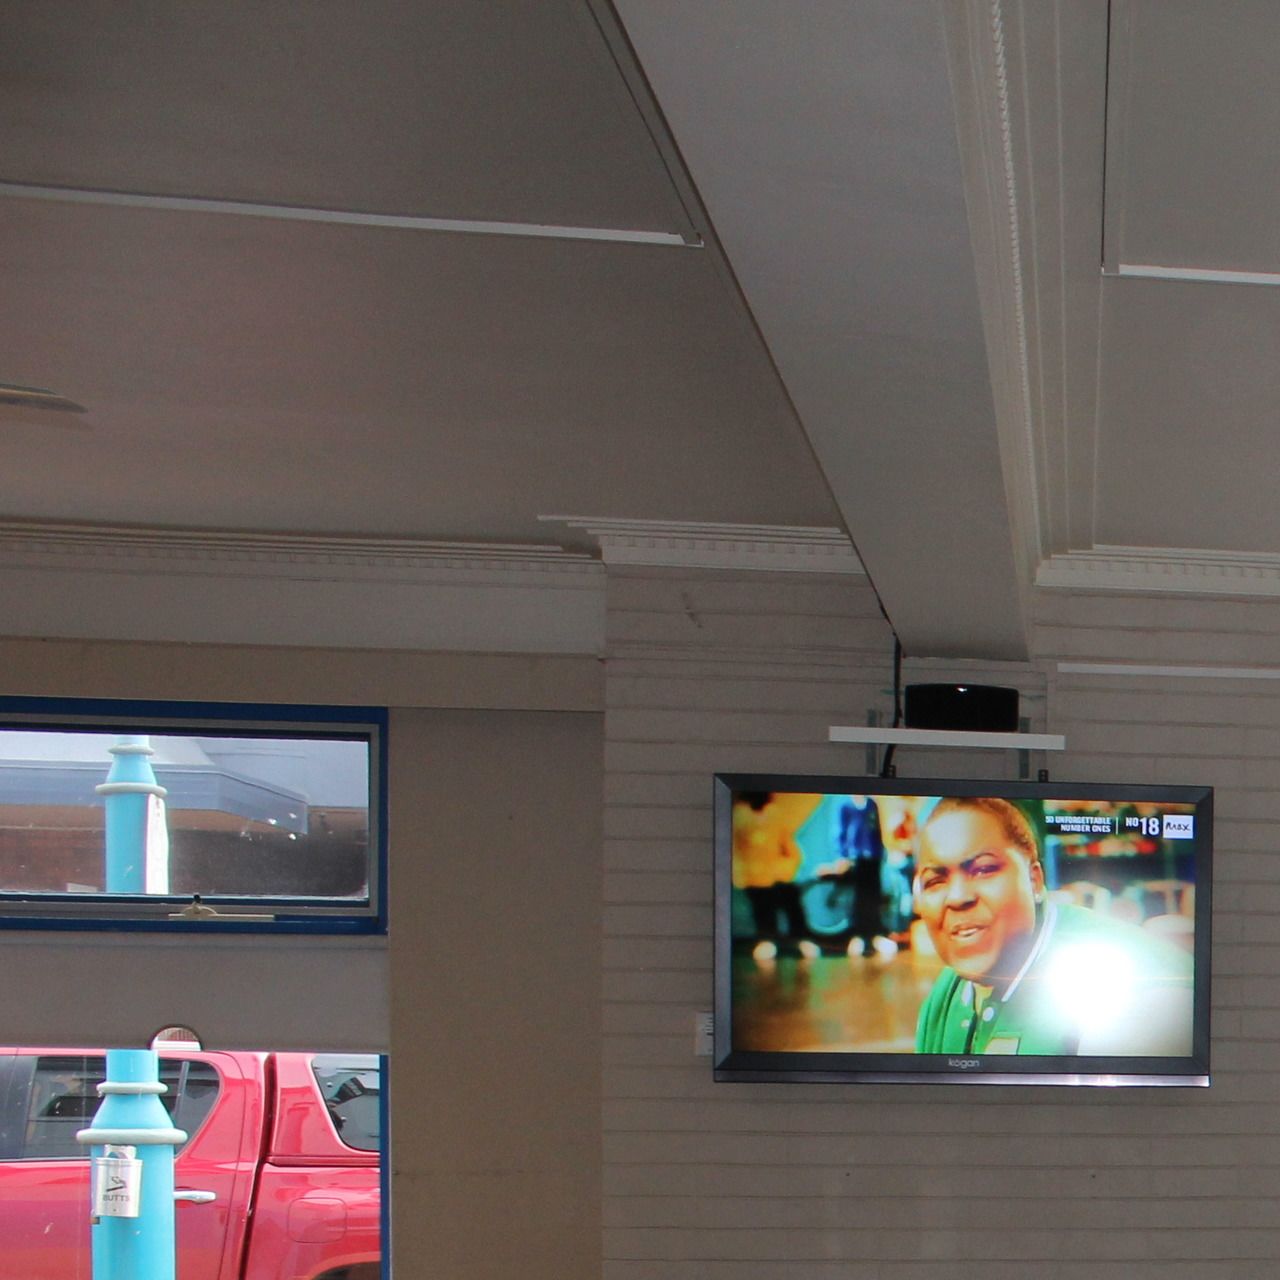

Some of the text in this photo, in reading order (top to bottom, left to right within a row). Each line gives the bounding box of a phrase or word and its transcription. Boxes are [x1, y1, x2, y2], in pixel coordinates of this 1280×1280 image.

[1055, 816, 1111, 825] UNFORGETTABLE
[1060, 824, 1090, 832] NUMBER
[1126, 816, 1160, 836] NO 18
[948, 1057, 980, 1069] kogan
[102, 1194, 131, 1202] BUTTS
